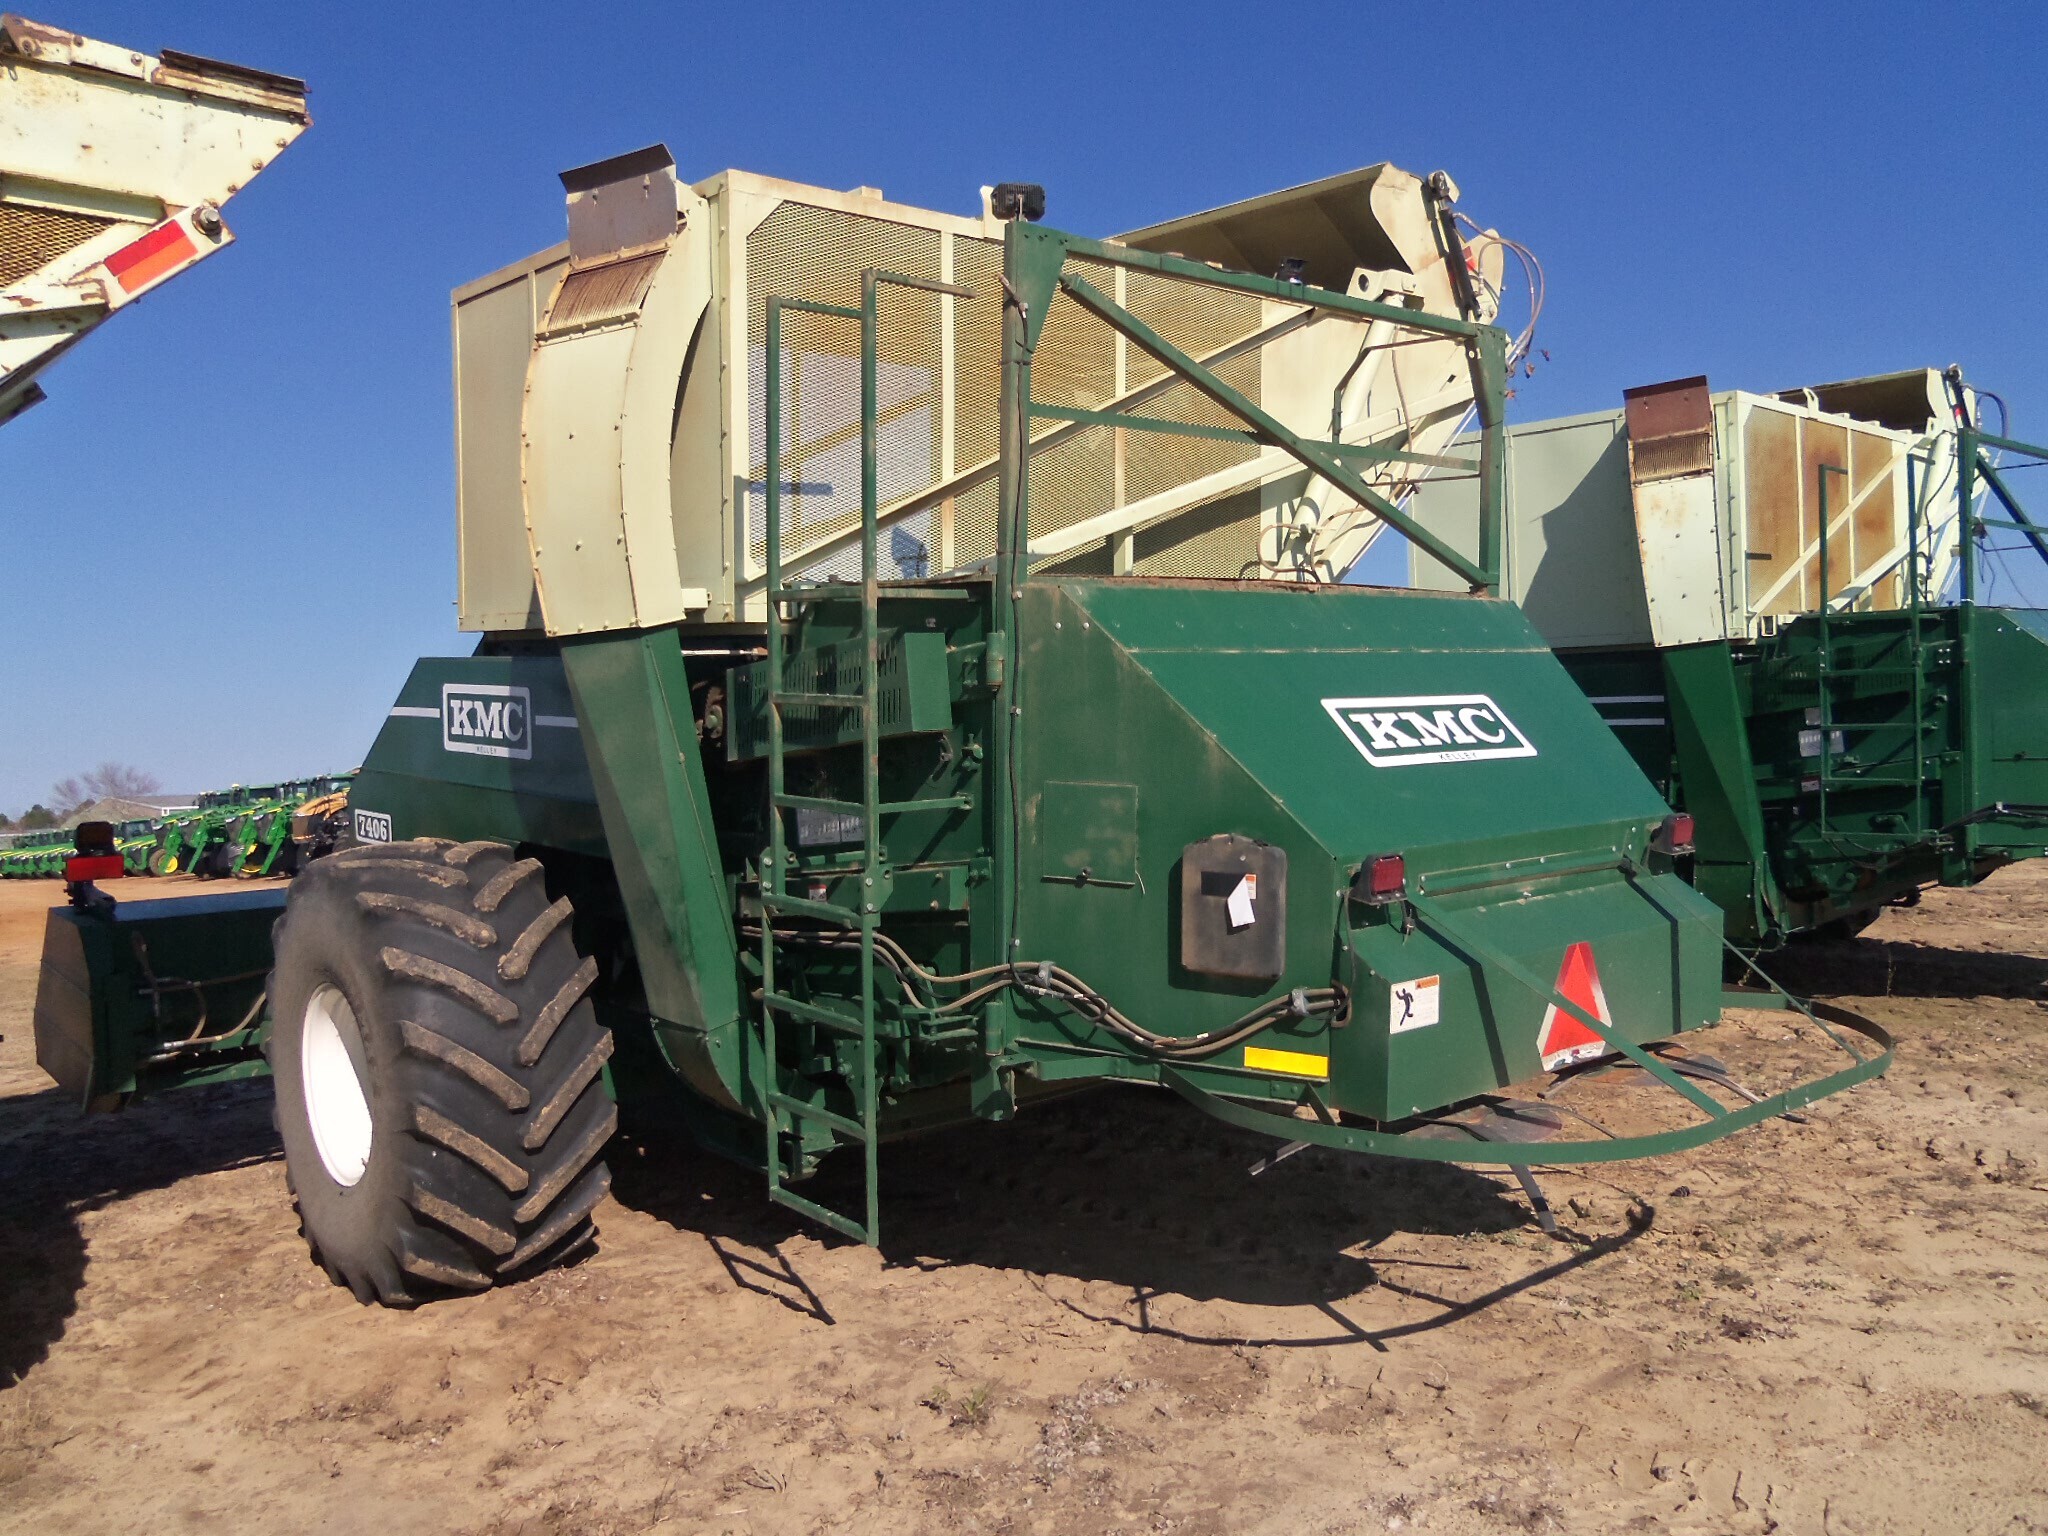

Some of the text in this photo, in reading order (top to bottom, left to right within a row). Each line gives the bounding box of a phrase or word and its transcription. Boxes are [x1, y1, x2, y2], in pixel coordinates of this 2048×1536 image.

[450, 699, 523, 742] KMC
[1348, 707, 1506, 750] KMC
[476, 746, 497, 756] KELLEY
[1438, 752, 1477, 761] KELLEY
[359, 816, 388, 841] 7406
